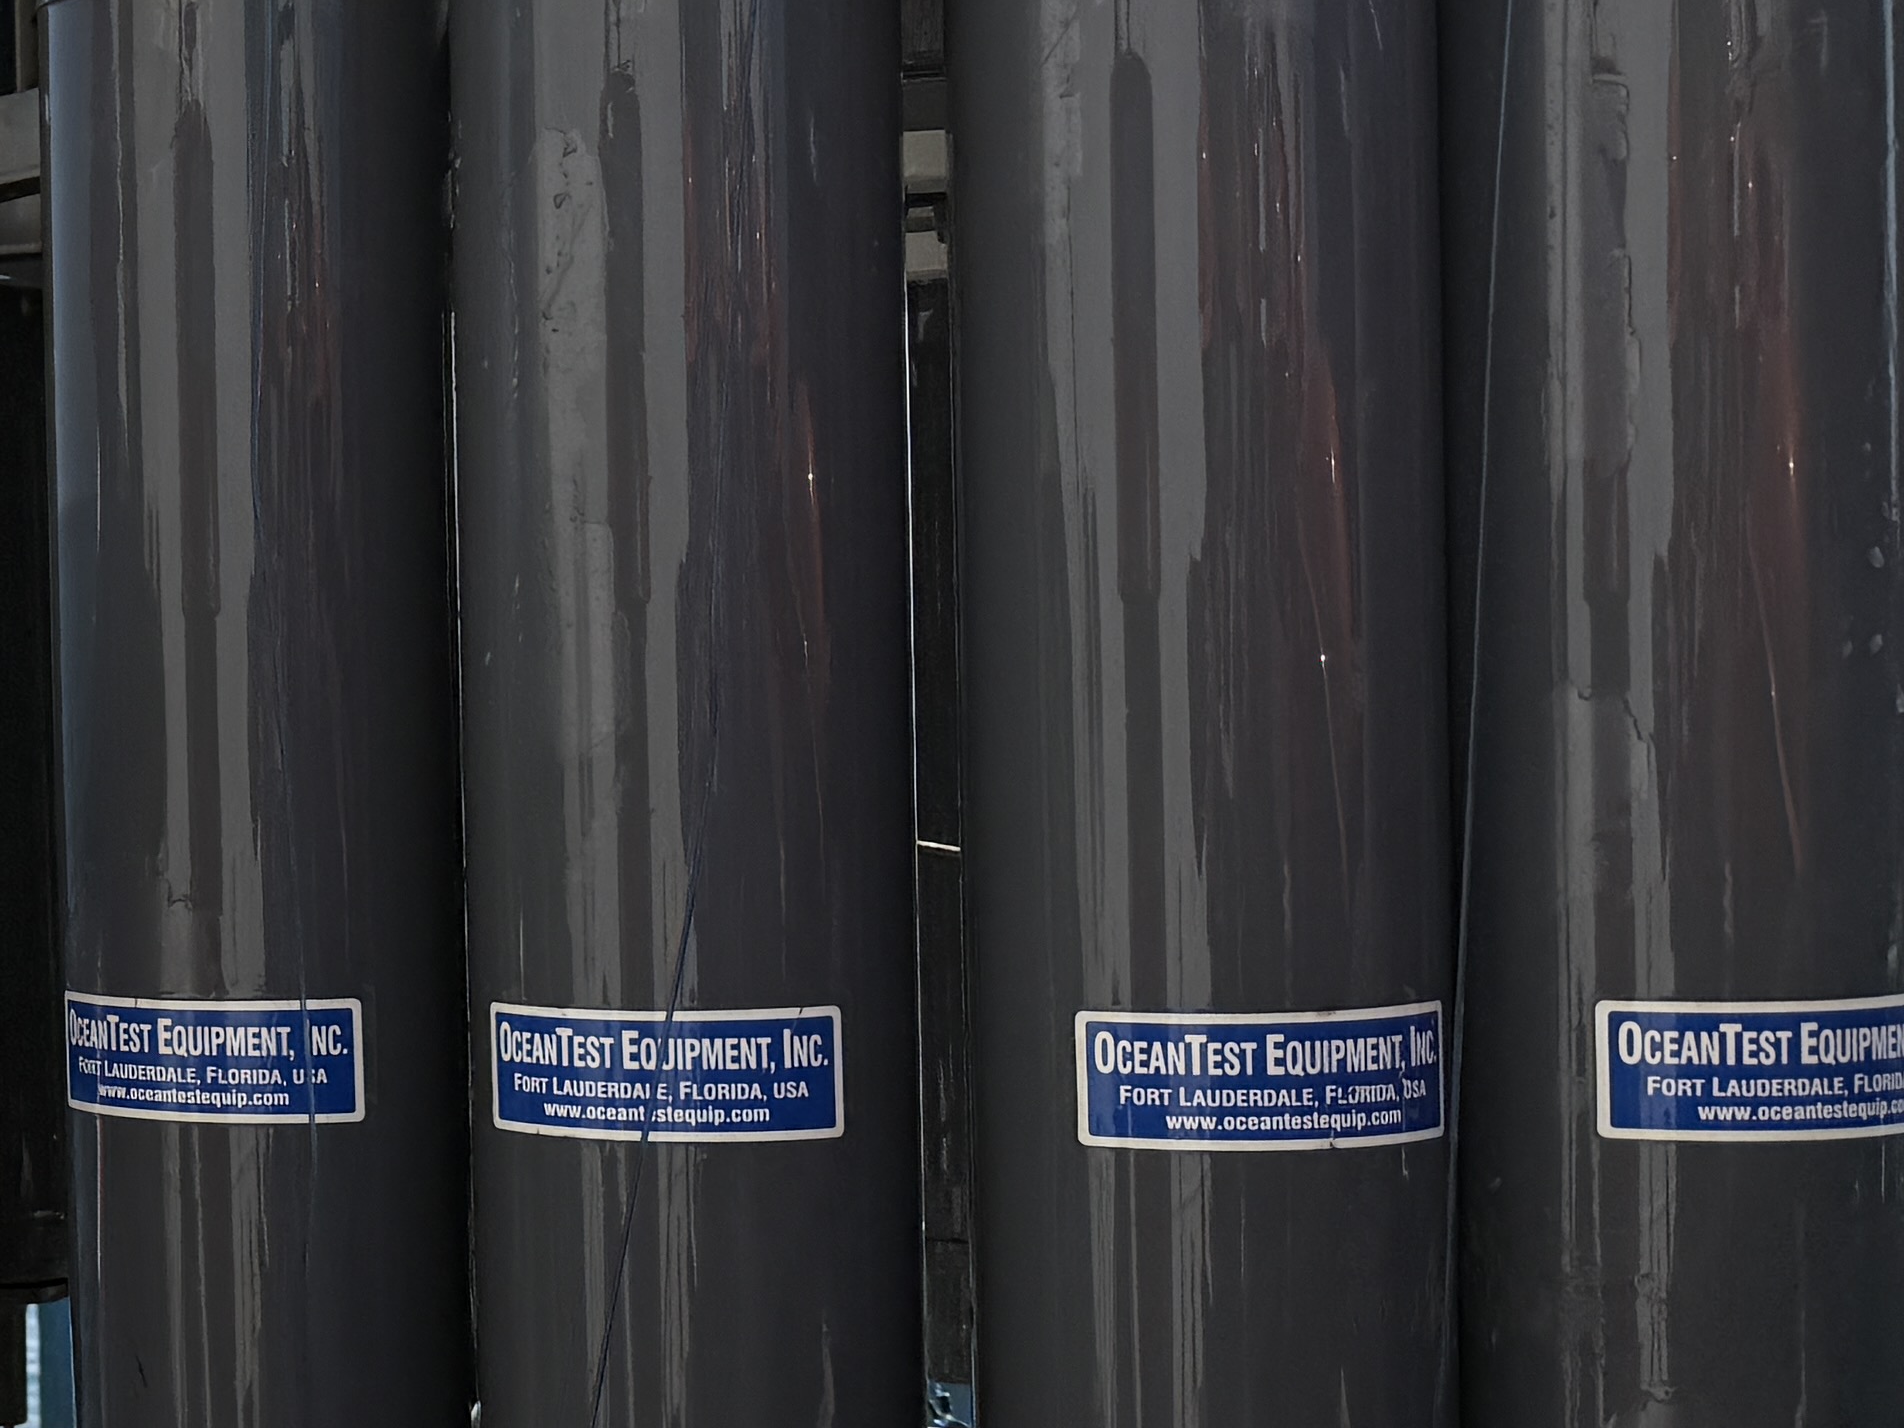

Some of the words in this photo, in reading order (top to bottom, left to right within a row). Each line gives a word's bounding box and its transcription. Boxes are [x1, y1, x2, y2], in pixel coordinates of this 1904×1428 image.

[783, 1028, 829, 1070] INC.
[514, 1074, 548, 1095] FORT
[679, 1081, 767, 1102] FLORIDA,
[773, 1080, 809, 1099] USA
[1119, 1085, 1172, 1106] FORT
[1179, 1085, 1319, 1109] LAUDERDALE,
[1647, 1076, 1705, 1097] FORT
[1712, 1076, 1849, 1098] LAUDERDALE,
[1166, 1109, 1401, 1133] www.oceantestequip.com
